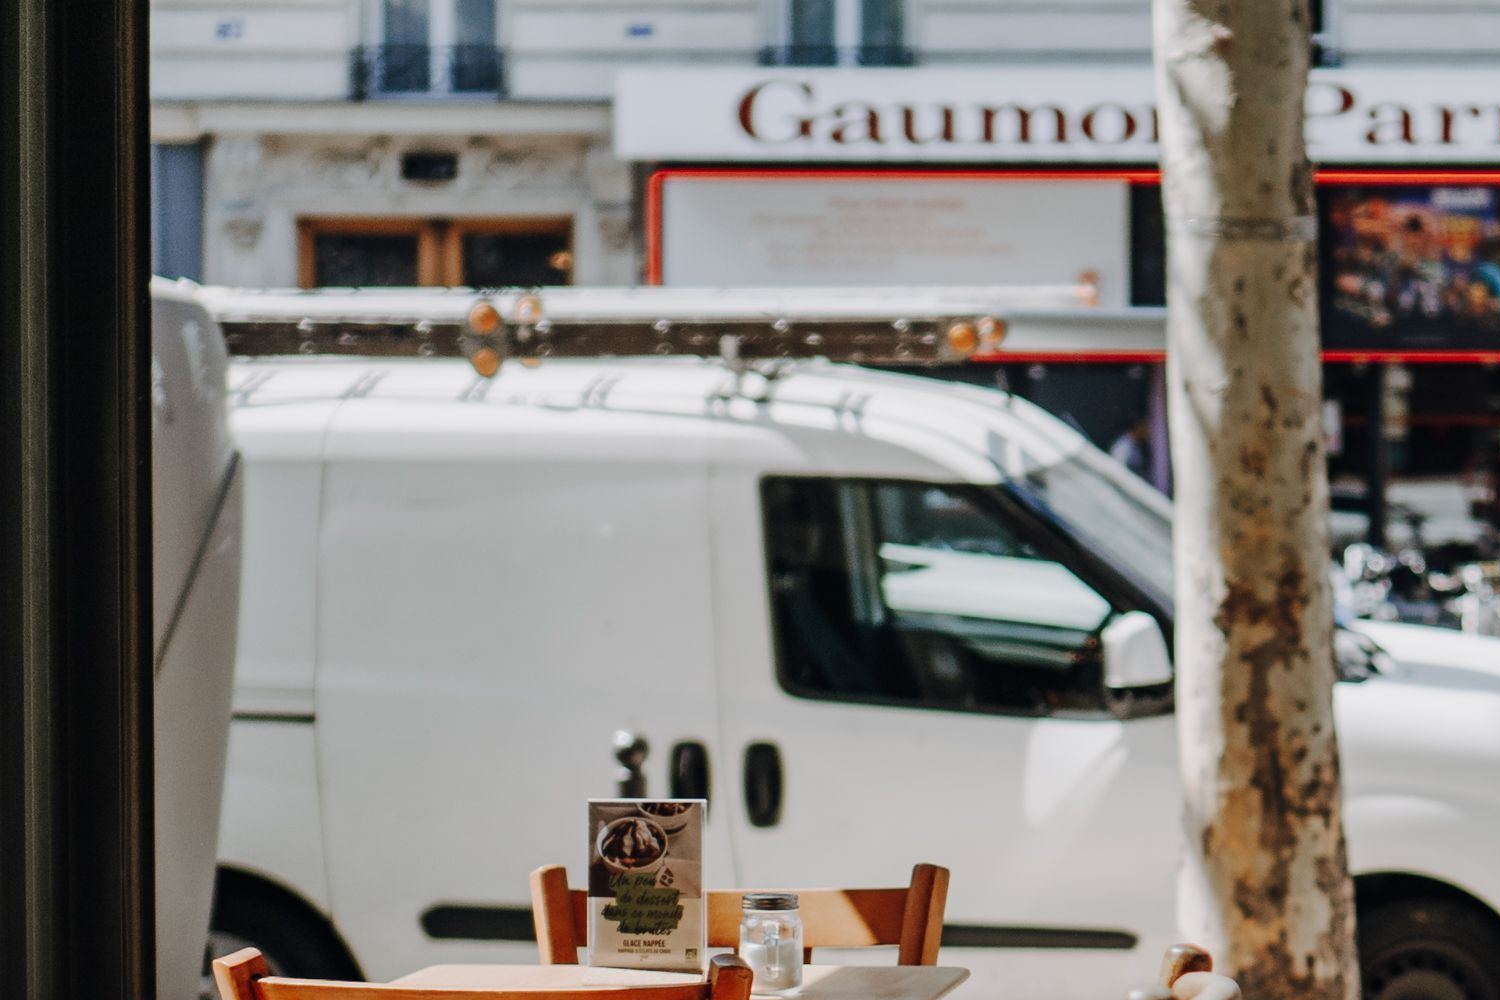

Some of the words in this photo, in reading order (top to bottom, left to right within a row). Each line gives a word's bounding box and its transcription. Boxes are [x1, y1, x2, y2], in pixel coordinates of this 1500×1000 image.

[739, 79, 1160, 145] Gaumo
[636, 889, 686, 905] dessert
[623, 939, 641, 948] GLACE
